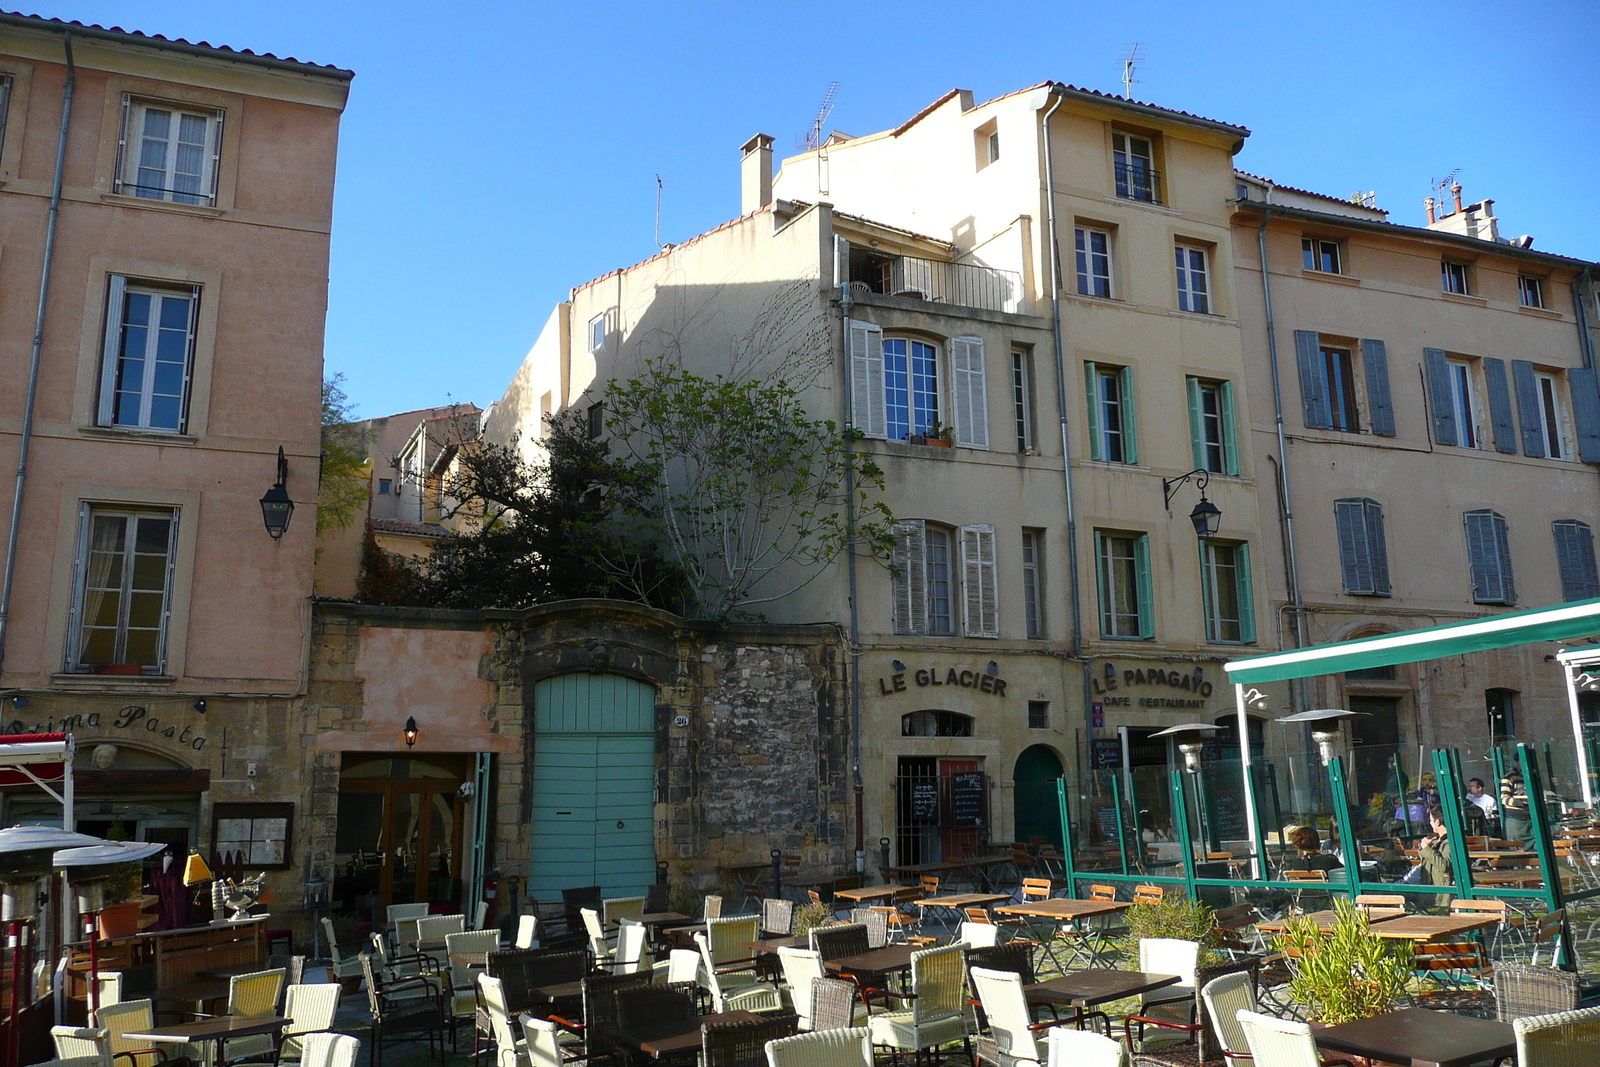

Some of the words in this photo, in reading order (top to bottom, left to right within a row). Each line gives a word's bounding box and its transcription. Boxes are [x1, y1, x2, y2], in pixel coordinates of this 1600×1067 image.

[879, 673, 907, 696] LE
[915, 667, 1008, 698] GLACIER
[1093, 674, 1118, 695] LE
[1124, 668, 1213, 698] PAPAGAYO
[1104, 696, 1130, 707] CAFE
[1139, 697, 1206, 709] RESTAURANT
[113, 705, 207, 751] Pasta
[677, 717, 686, 725] 26
